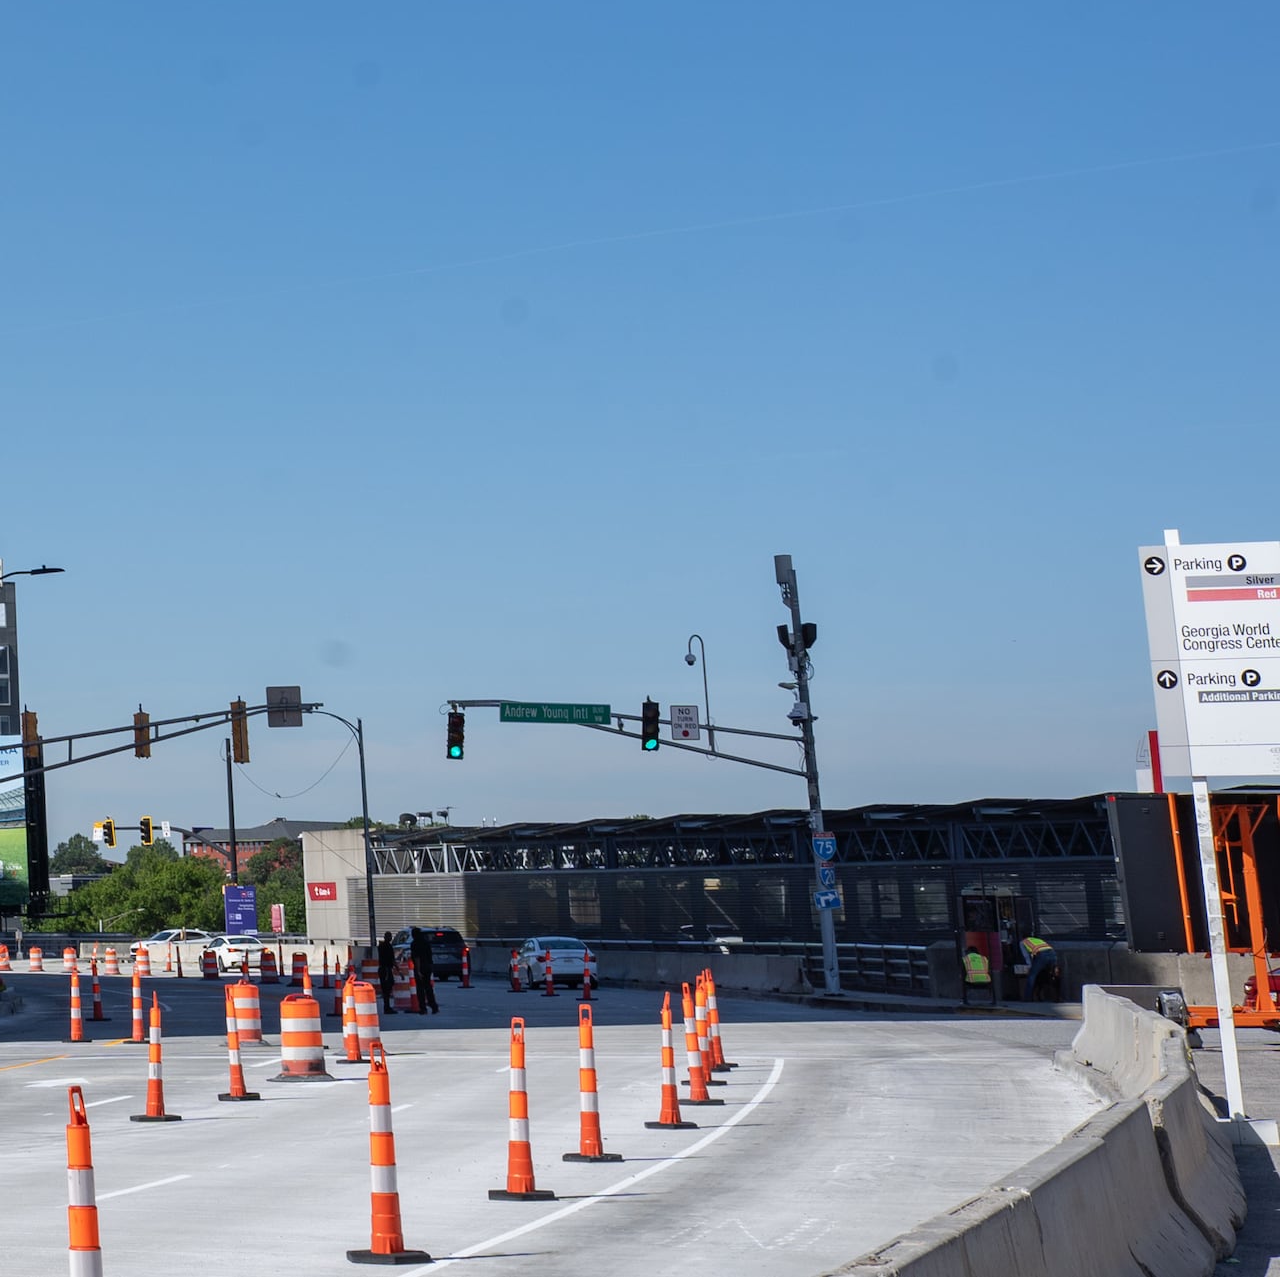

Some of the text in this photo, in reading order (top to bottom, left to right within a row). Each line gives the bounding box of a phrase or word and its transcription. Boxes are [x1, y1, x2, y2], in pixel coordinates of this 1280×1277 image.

[1174, 557, 1222, 572] Parking
[1246, 575, 1275, 585] Silver
[1257, 589, 1277, 599] Red
[1181, 623, 1270, 639] Georgia World
[1183, 636, 1280, 653] Congress Cente
[1187, 672, 1236, 687] Parking
[1201, 691, 1280, 702] Additional Parkin
[504, 705, 588, 722] Andrew Young Intl
[816, 841, 833, 855] 75
